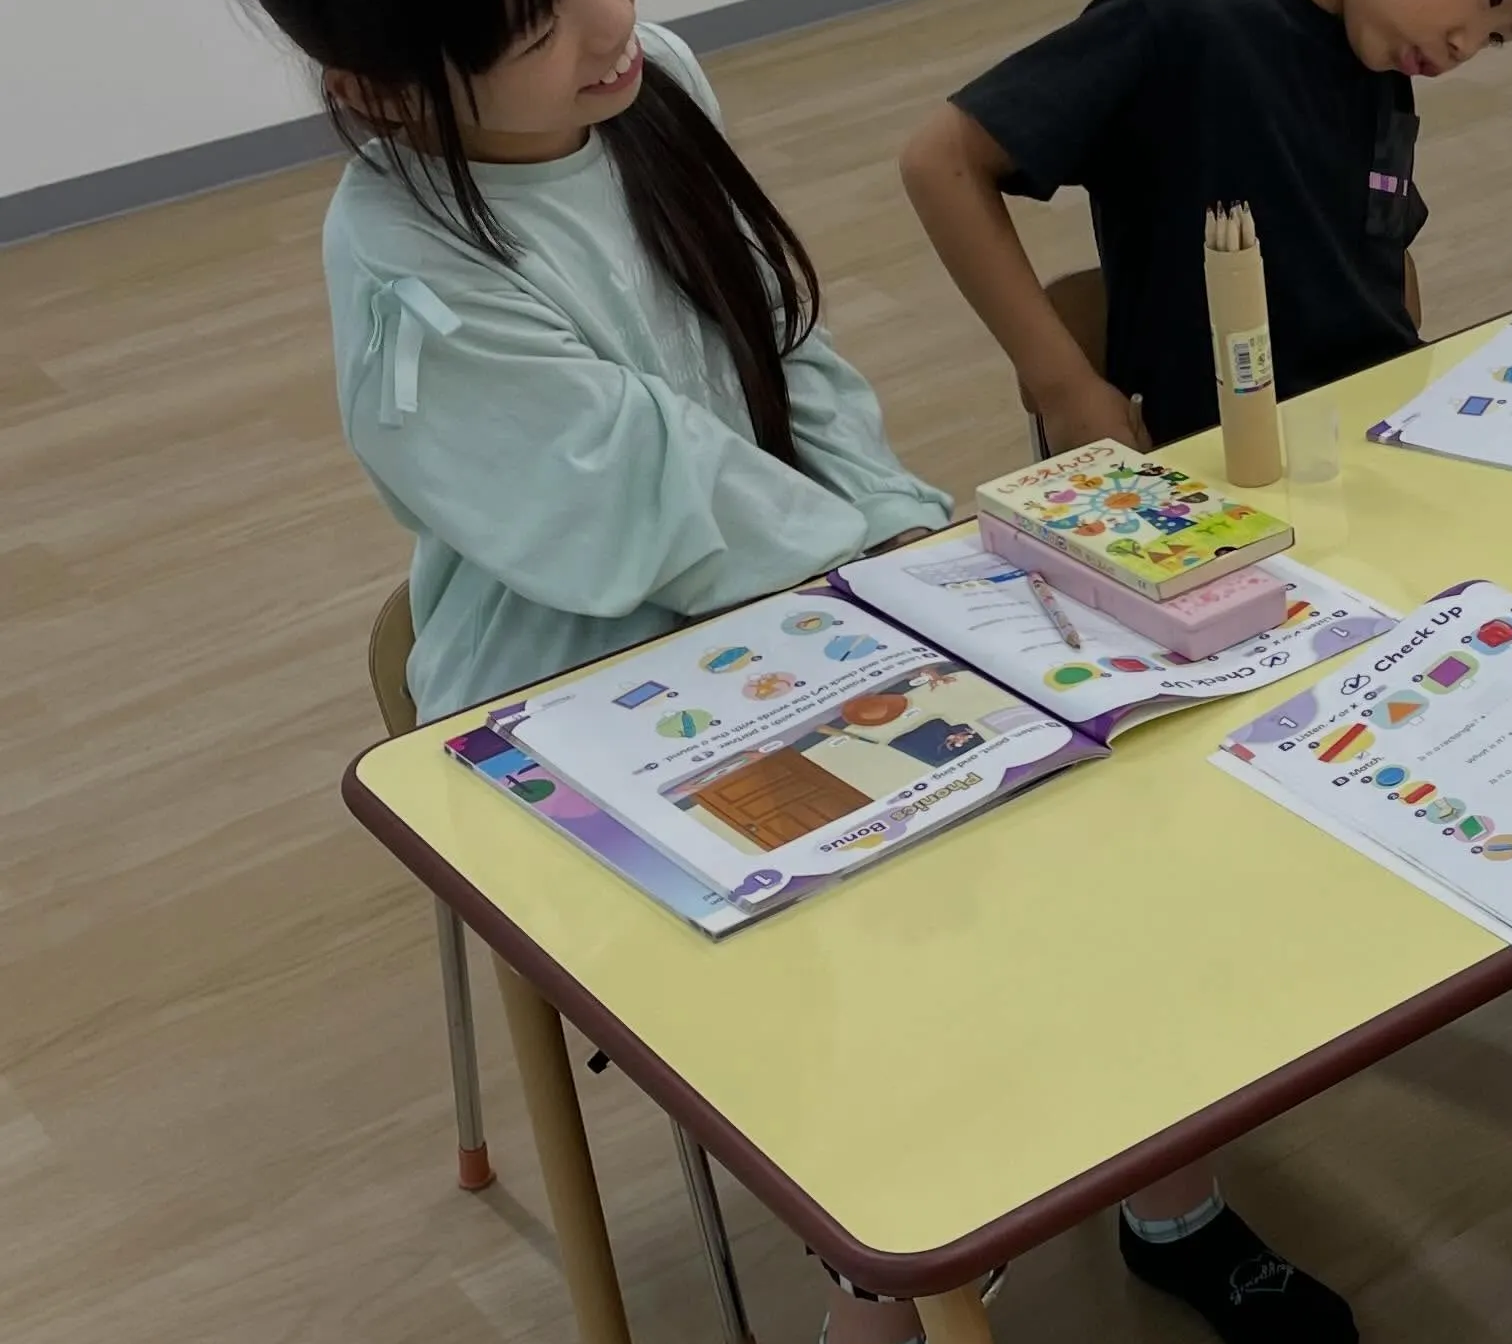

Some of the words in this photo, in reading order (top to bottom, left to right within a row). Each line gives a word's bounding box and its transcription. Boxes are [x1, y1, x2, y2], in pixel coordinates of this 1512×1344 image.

[1331, 626, 1349, 637] 1
[1373, 624, 1434, 673] Check
[1431, 605, 1464, 628] Up
[1159, 679, 1193, 689] Up
[1191, 666, 1256, 687] Check
[1278, 716, 1298, 729] 1
[1348, 756, 1385, 777] Match.
[889, 771, 984, 821] Phonics
[820, 821, 888, 853] Bonus
[754, 874, 773, 886] 1
